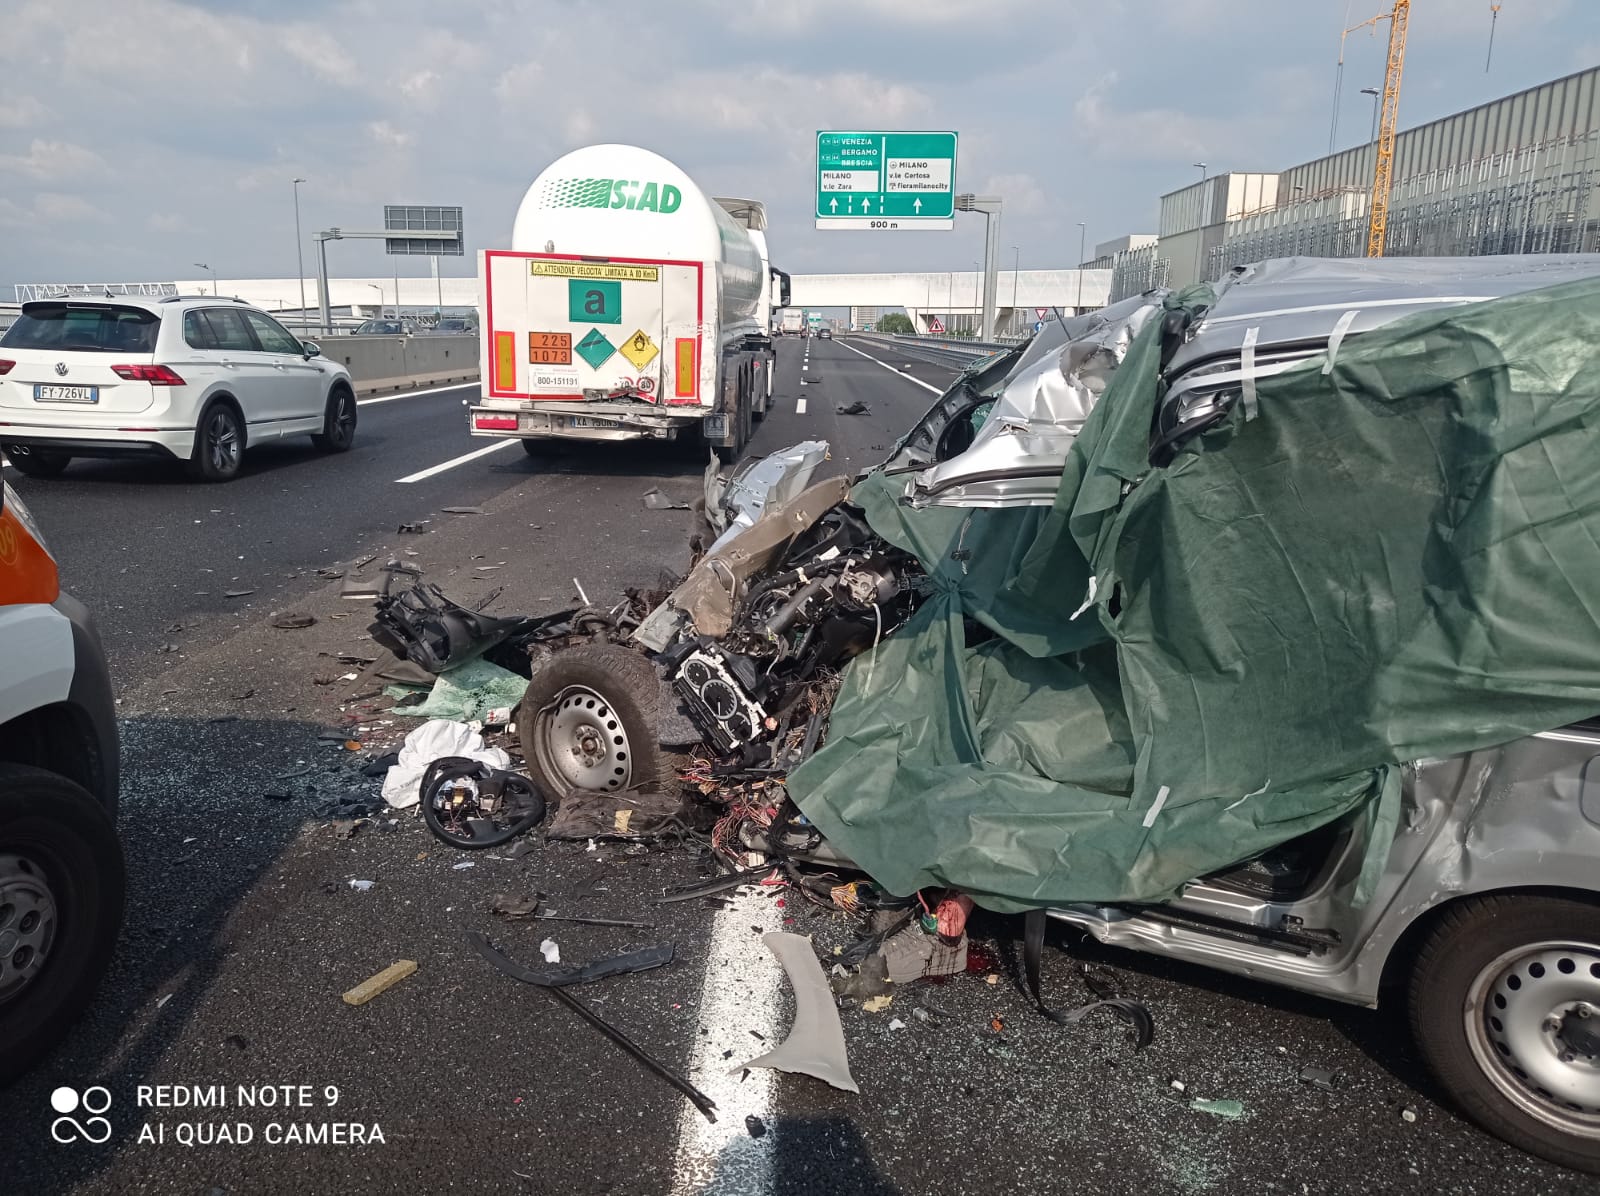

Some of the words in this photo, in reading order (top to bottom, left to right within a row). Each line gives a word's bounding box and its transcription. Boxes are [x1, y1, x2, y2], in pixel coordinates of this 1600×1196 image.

[841, 148, 878, 156] BERGAMO
[841, 159, 873, 167] BRESCIA
[899, 161, 928, 169] MILANO
[823, 172, 852, 180] MILANO
[544, 264, 575, 275] ATTENZIONE
[605, 267, 628, 278] LIMITATA
[629, 269, 634, 277] A
[584, 288, 606, 315] a
[541, 334, 567, 347] 225
[533, 350, 567, 362] 1073
[537, 376, 578, 386] 800-151191
[640, 380, 651, 389] 80
